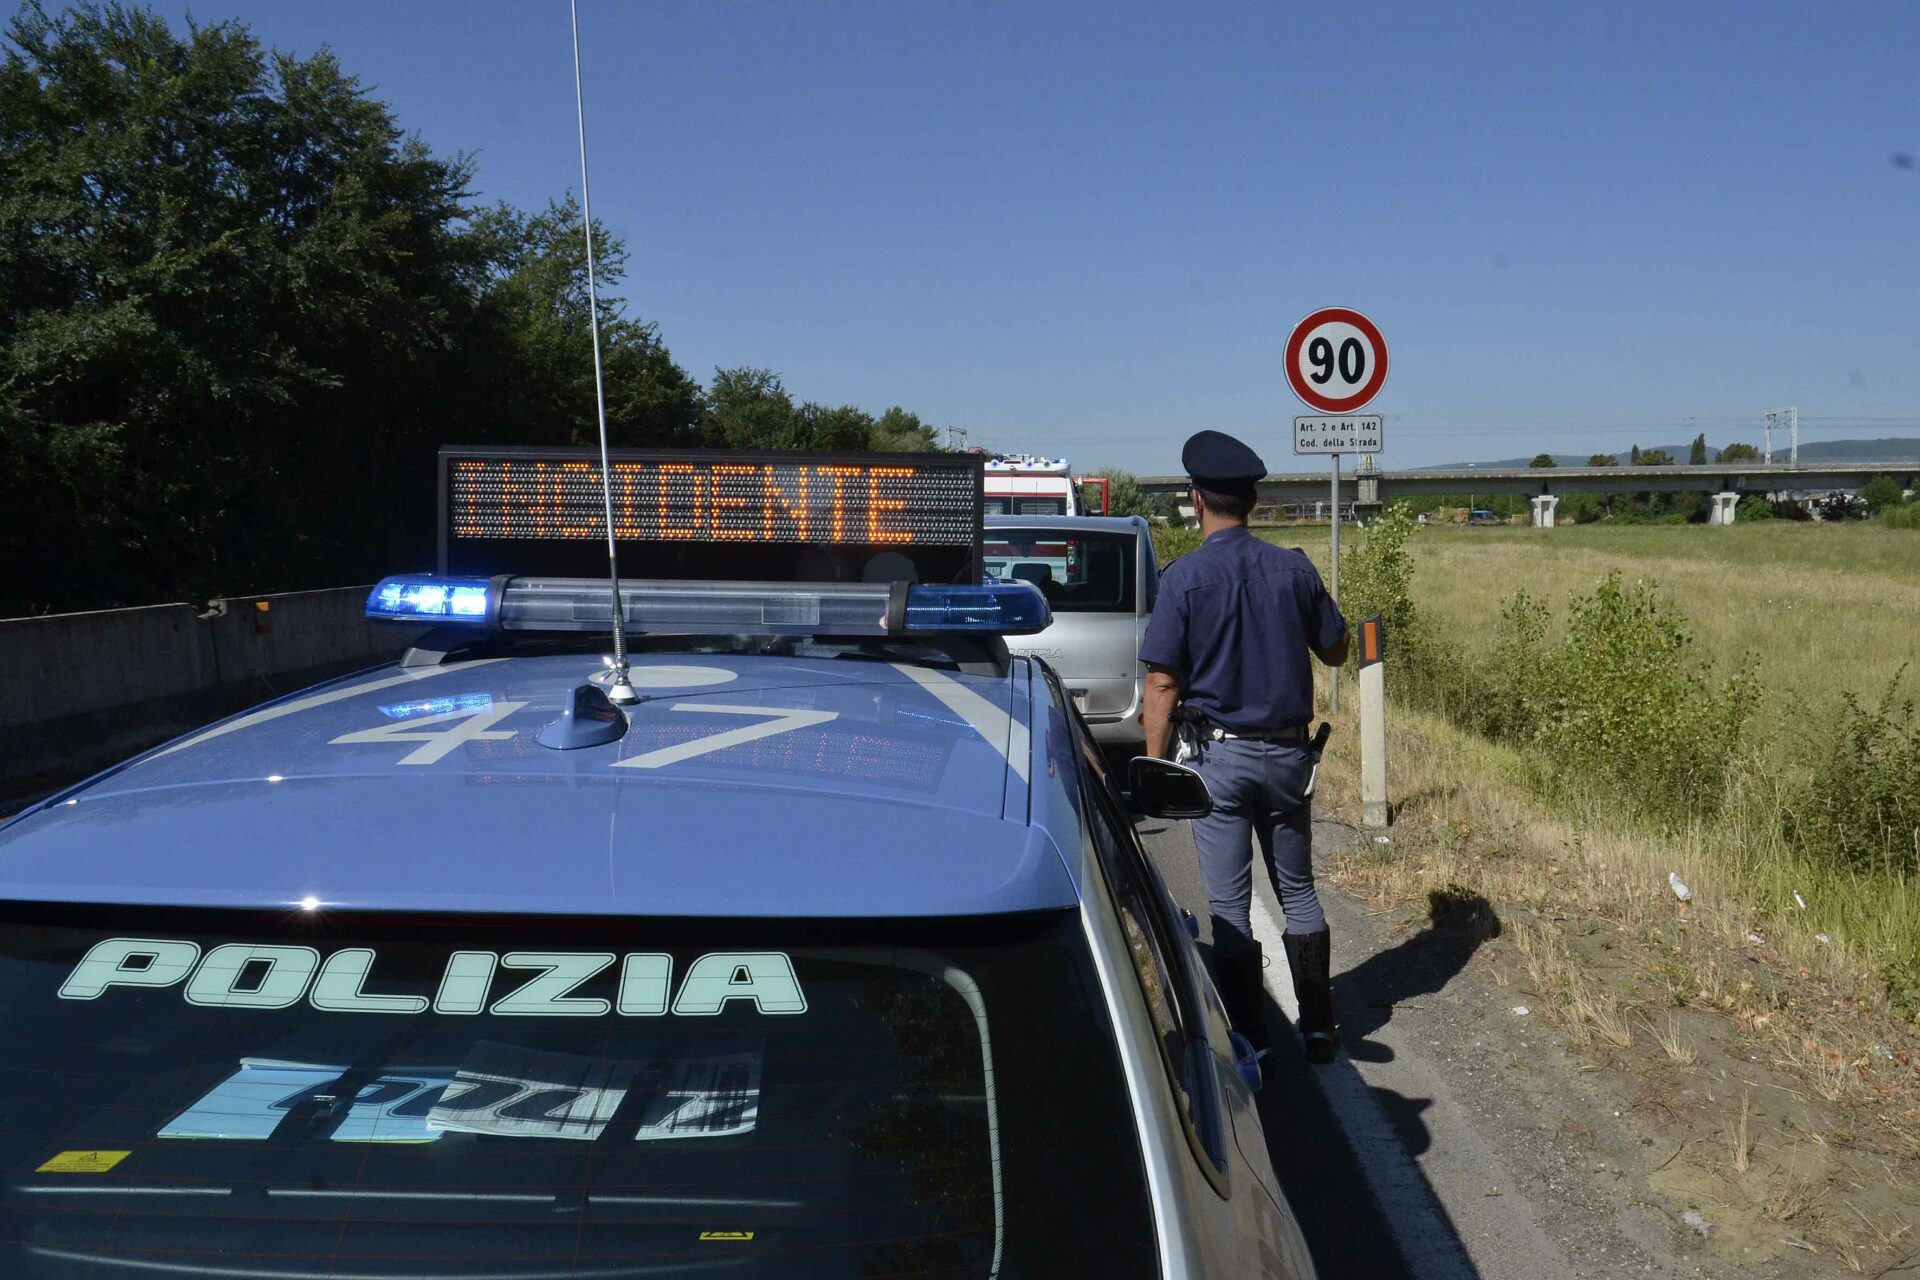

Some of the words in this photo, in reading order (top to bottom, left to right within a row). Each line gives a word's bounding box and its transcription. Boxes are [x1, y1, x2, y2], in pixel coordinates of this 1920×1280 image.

[1308, 337, 1365, 384] 90
[1300, 422, 1317, 432] Art.
[1321, 422, 1327, 431] 2
[1340, 422, 1357, 431] Art.
[1361, 421, 1377, 431] 142
[1300, 438, 1318, 448] Cod.
[1323, 438, 1345, 447] della
[458, 462, 914, 542] INCIDENTE
[57, 937, 808, 1017] POLIZIA
